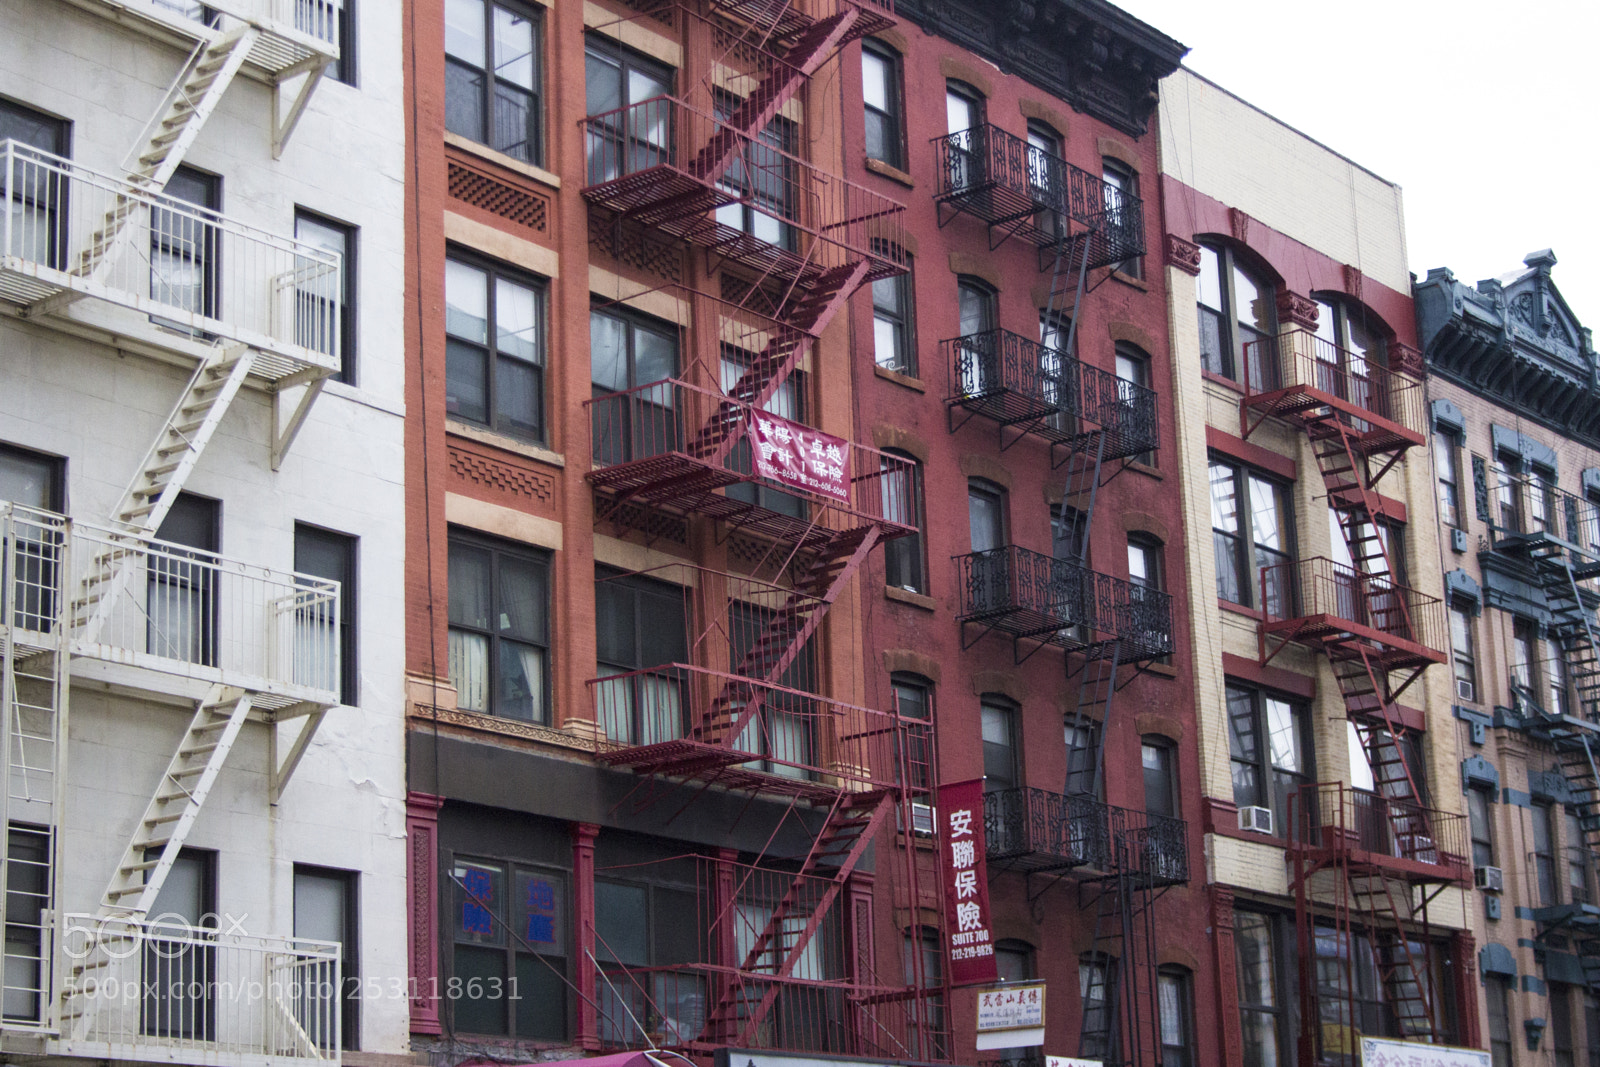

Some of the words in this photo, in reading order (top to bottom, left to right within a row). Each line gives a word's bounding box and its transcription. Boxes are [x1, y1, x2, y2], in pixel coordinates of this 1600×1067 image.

[759, 441, 793, 466] 會計
[810, 438, 843, 466] 卓越
[812, 459, 844, 484] 保險
[950, 809, 983, 932] 安聯保險
[952, 932, 974, 946] SUITE
[975, 929, 989, 942] 700
